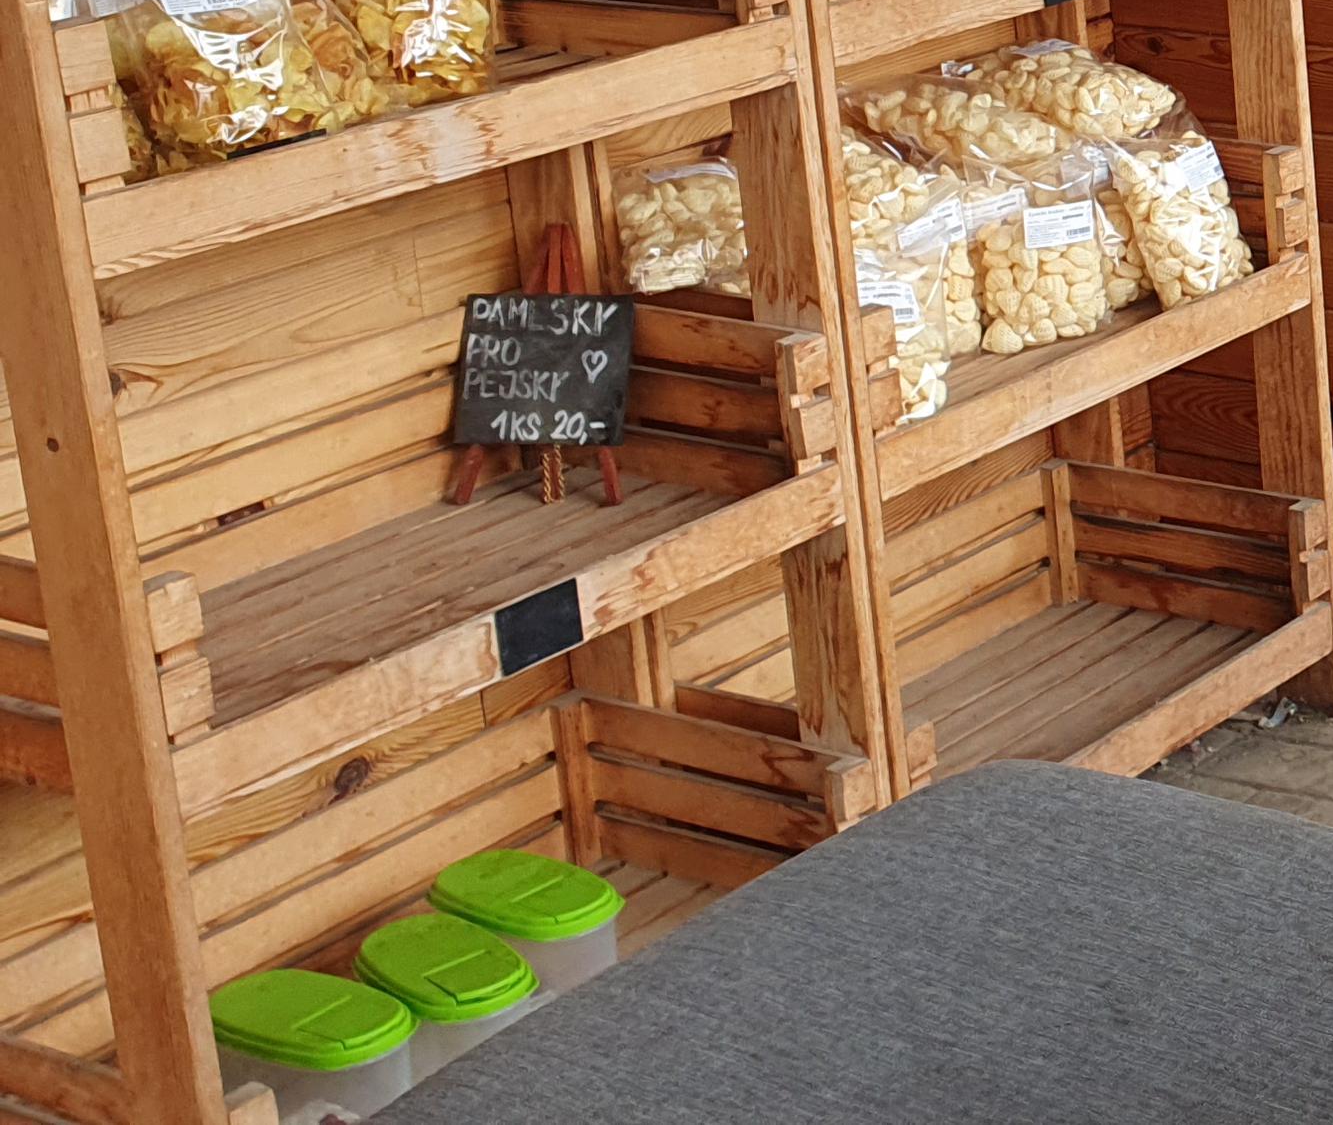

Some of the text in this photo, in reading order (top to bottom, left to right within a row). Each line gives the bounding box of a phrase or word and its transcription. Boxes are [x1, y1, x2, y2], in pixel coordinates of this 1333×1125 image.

[465, 332, 522, 367] PRO
[462, 368, 569, 404] PEJSKY
[550, 409, 606, 445] 20,-
